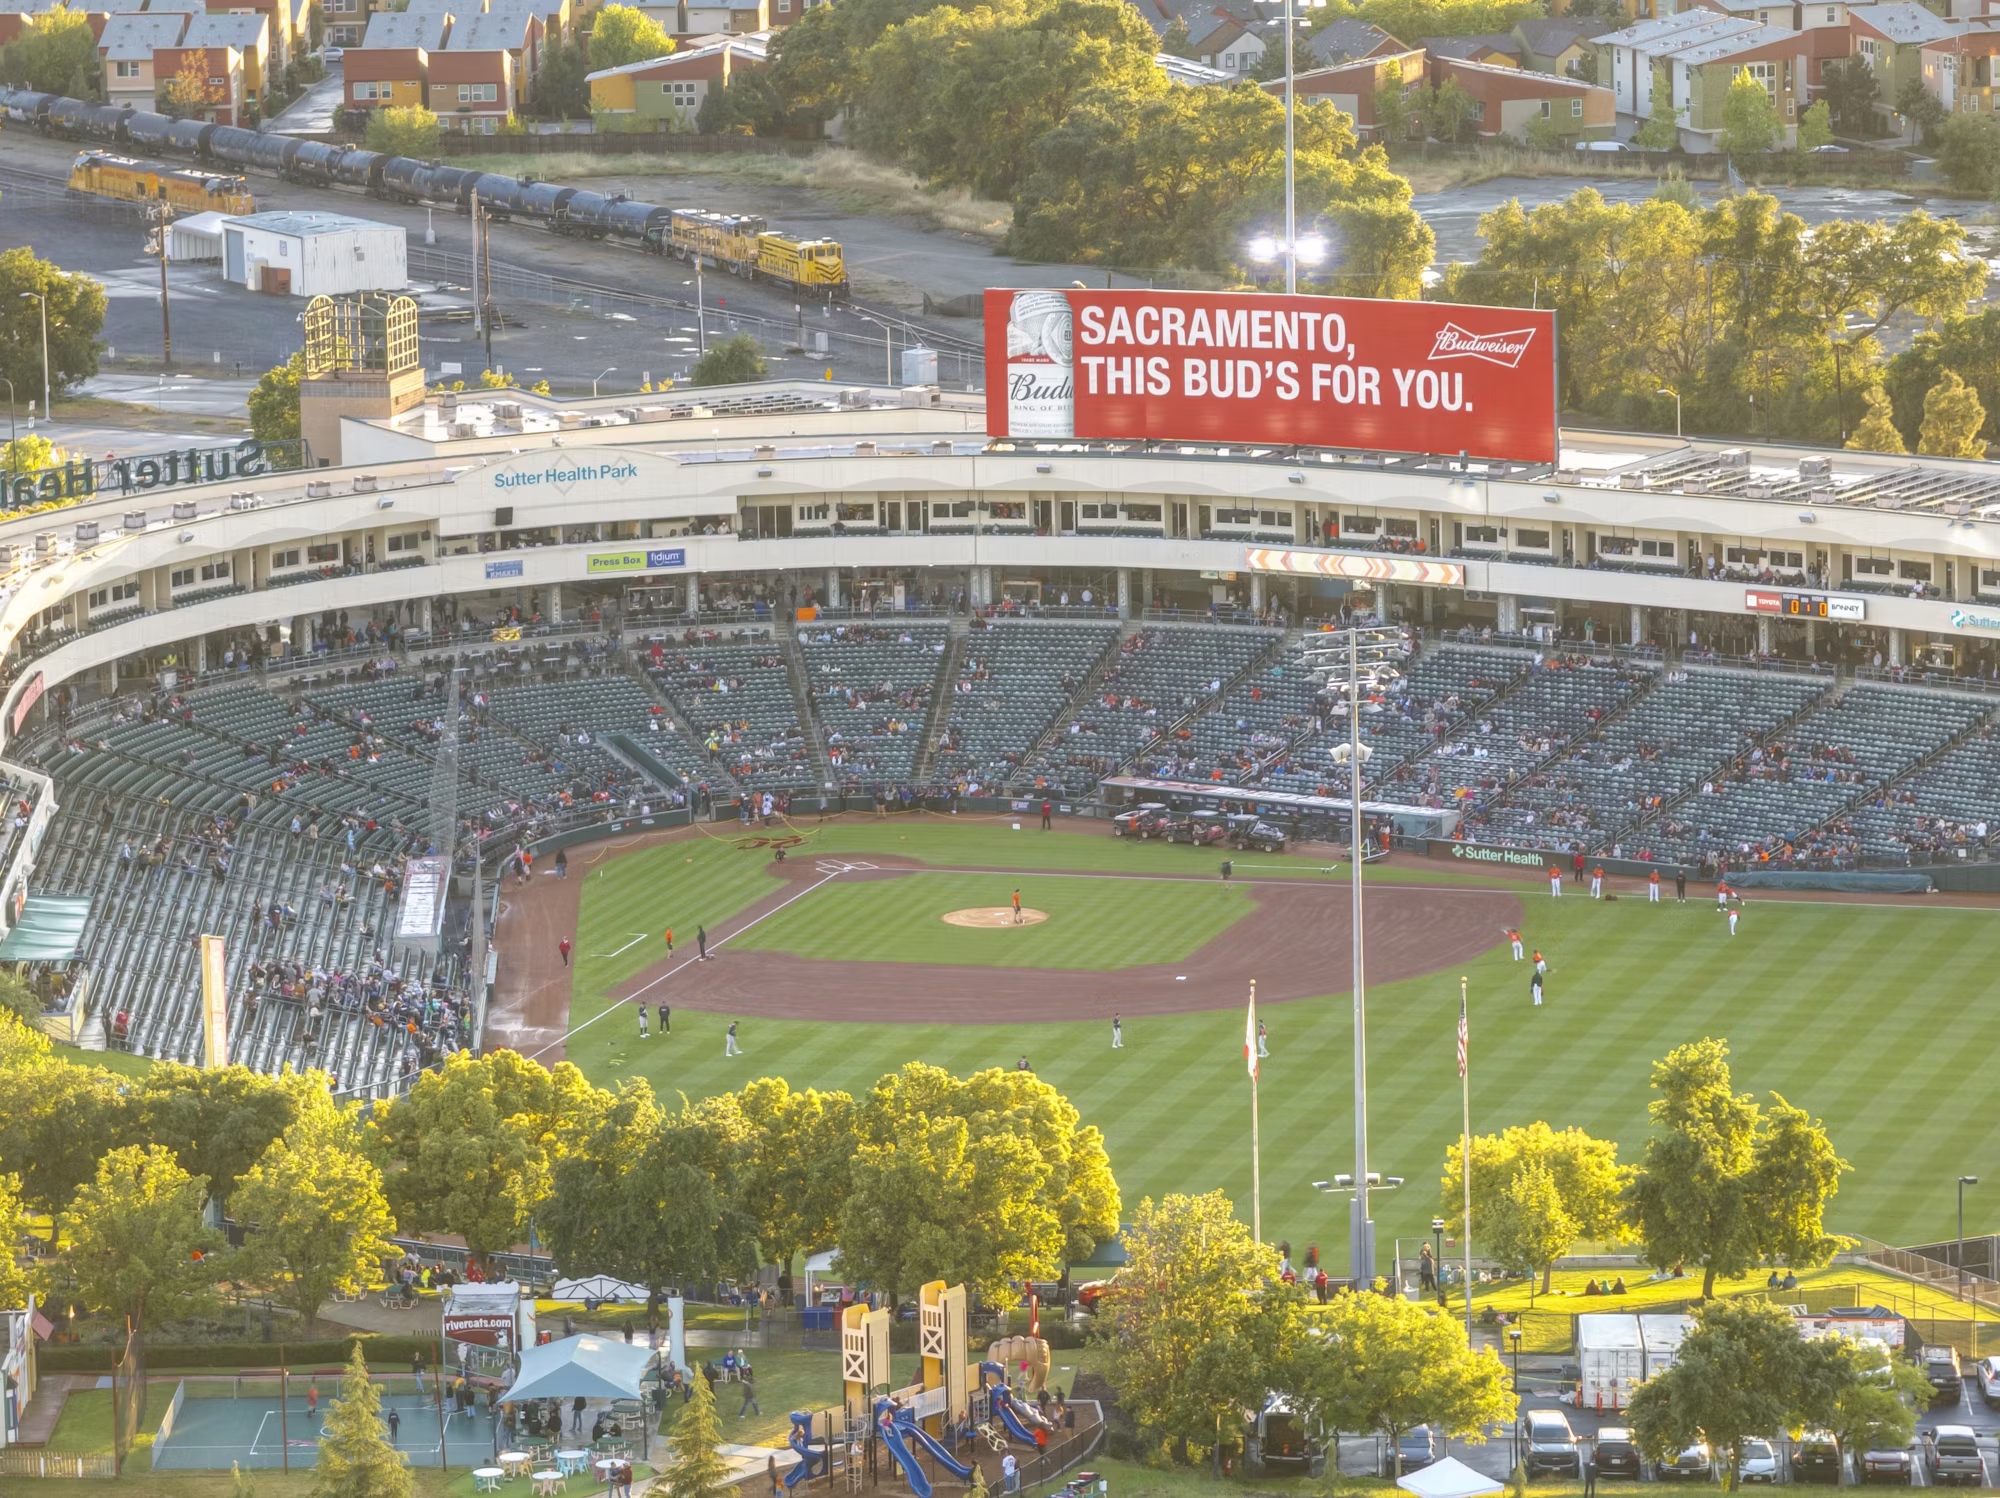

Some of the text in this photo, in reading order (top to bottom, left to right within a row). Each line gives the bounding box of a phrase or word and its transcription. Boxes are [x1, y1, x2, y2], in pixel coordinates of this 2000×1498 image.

[1081, 305, 1355, 361] SACRAMENTO,
[1436, 330, 1525, 354] Budweiser
[1081, 356, 1473, 412] THIS BUD'S FOR YOU.
[494, 464, 638, 488] Sutter Health Park
[592, 556, 641, 566] Press Box
[651, 552, 680, 566] fidium
[1758, 598, 1780, 606] TOYOTA
[1791, 600, 1799, 613] 0
[1819, 602, 1827, 616] 0
[1831, 604, 1860, 613] BONNEY
[1968, 615, 2000, 628] Sutter
[1465, 846, 1543, 866] Sutter Health
[446, 1318, 512, 1331] rivercats.com
